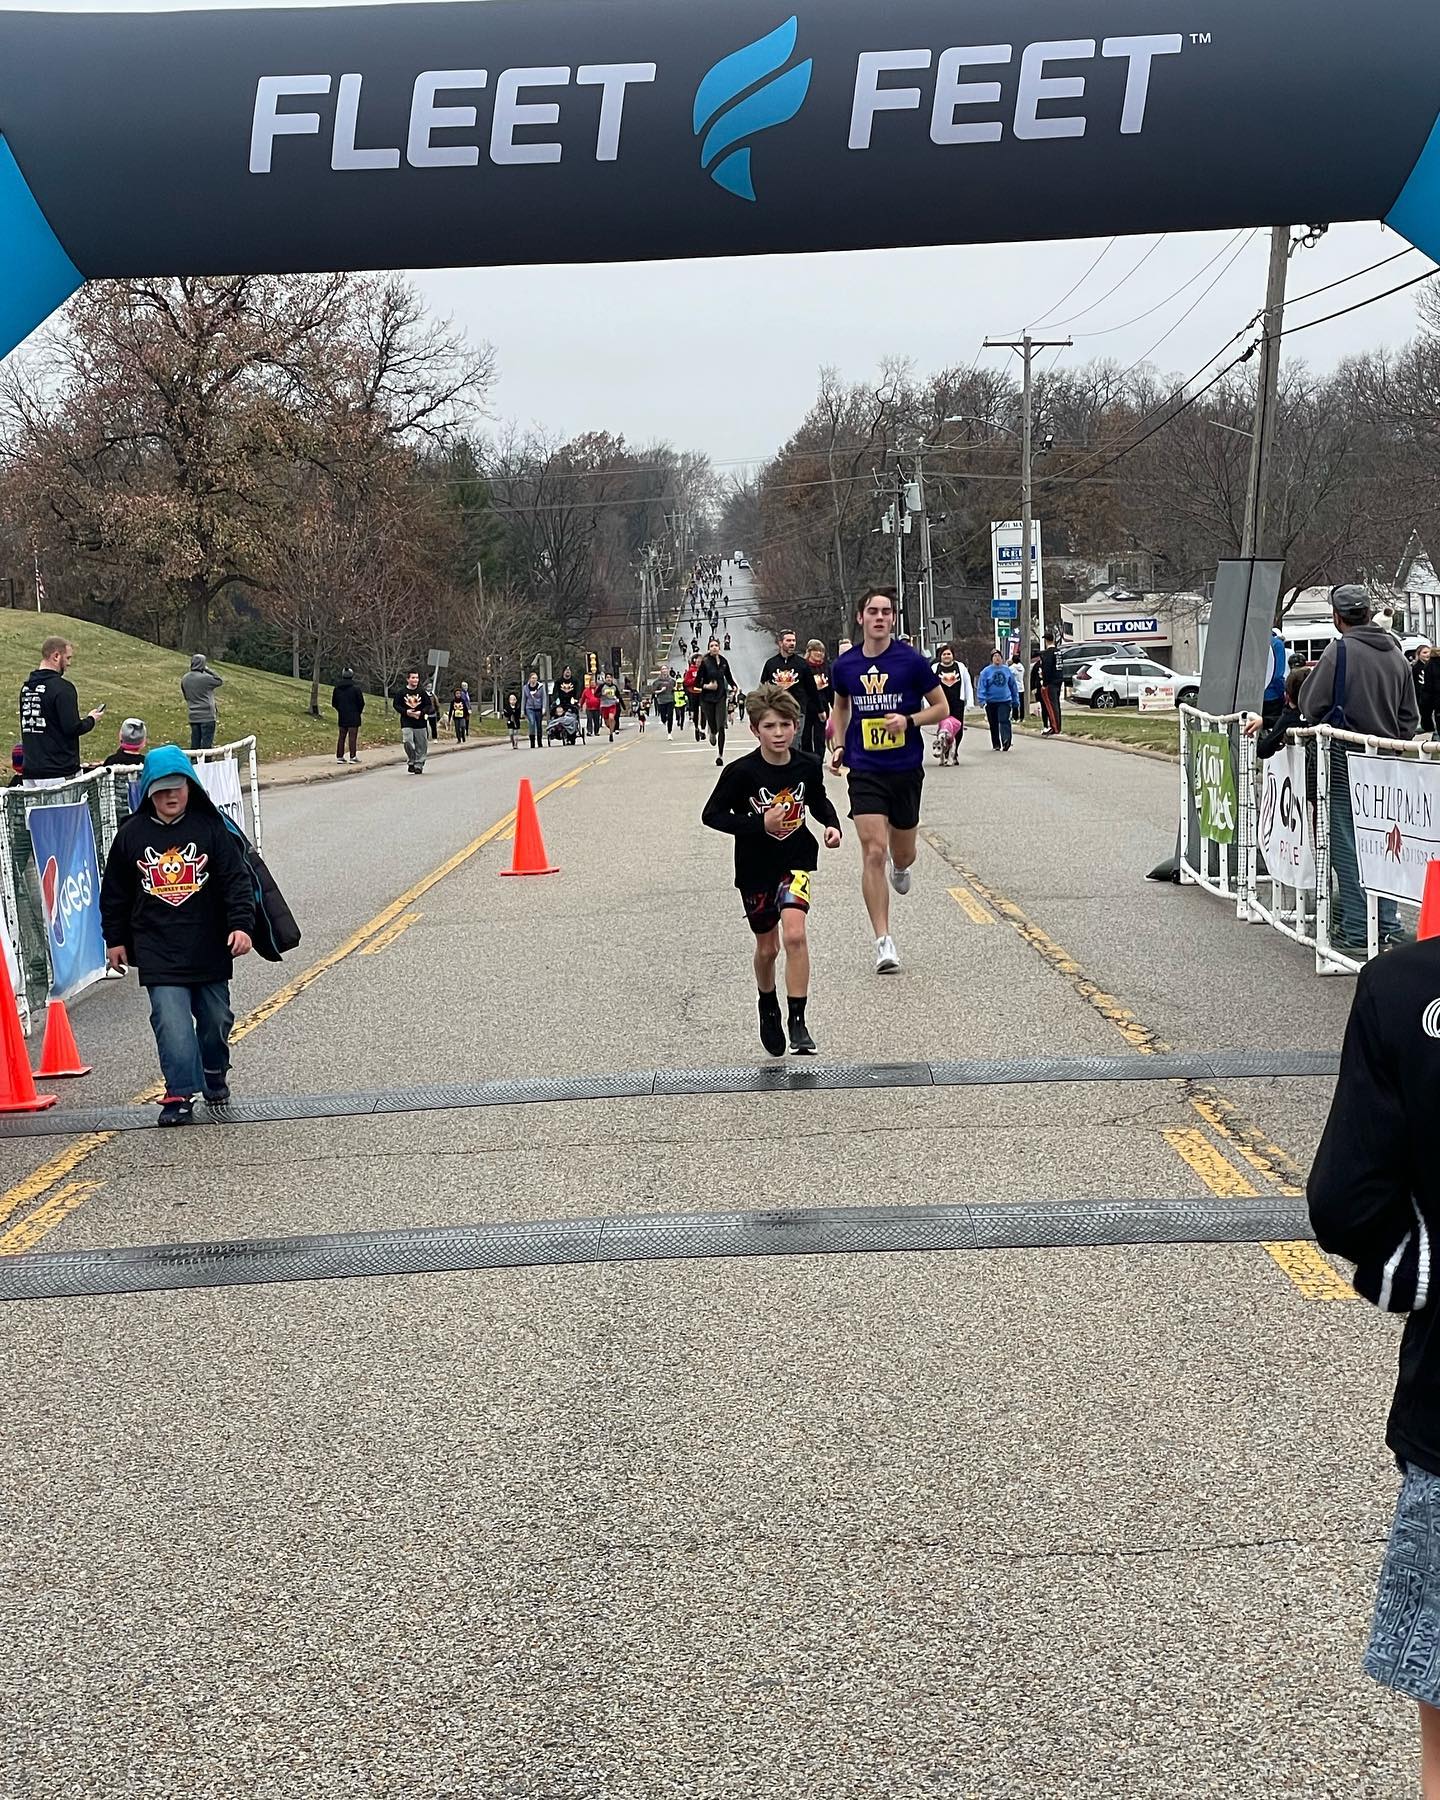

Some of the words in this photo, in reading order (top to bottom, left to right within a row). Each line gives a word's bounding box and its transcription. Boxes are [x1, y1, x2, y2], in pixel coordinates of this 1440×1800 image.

[249, 62, 657, 173] FLEET
[848, 33, 1184, 150] FEET
[1096, 622, 1122, 632] EXIT
[1125, 620, 1154, 631] ONLY
[859, 673, 889, 695] W
